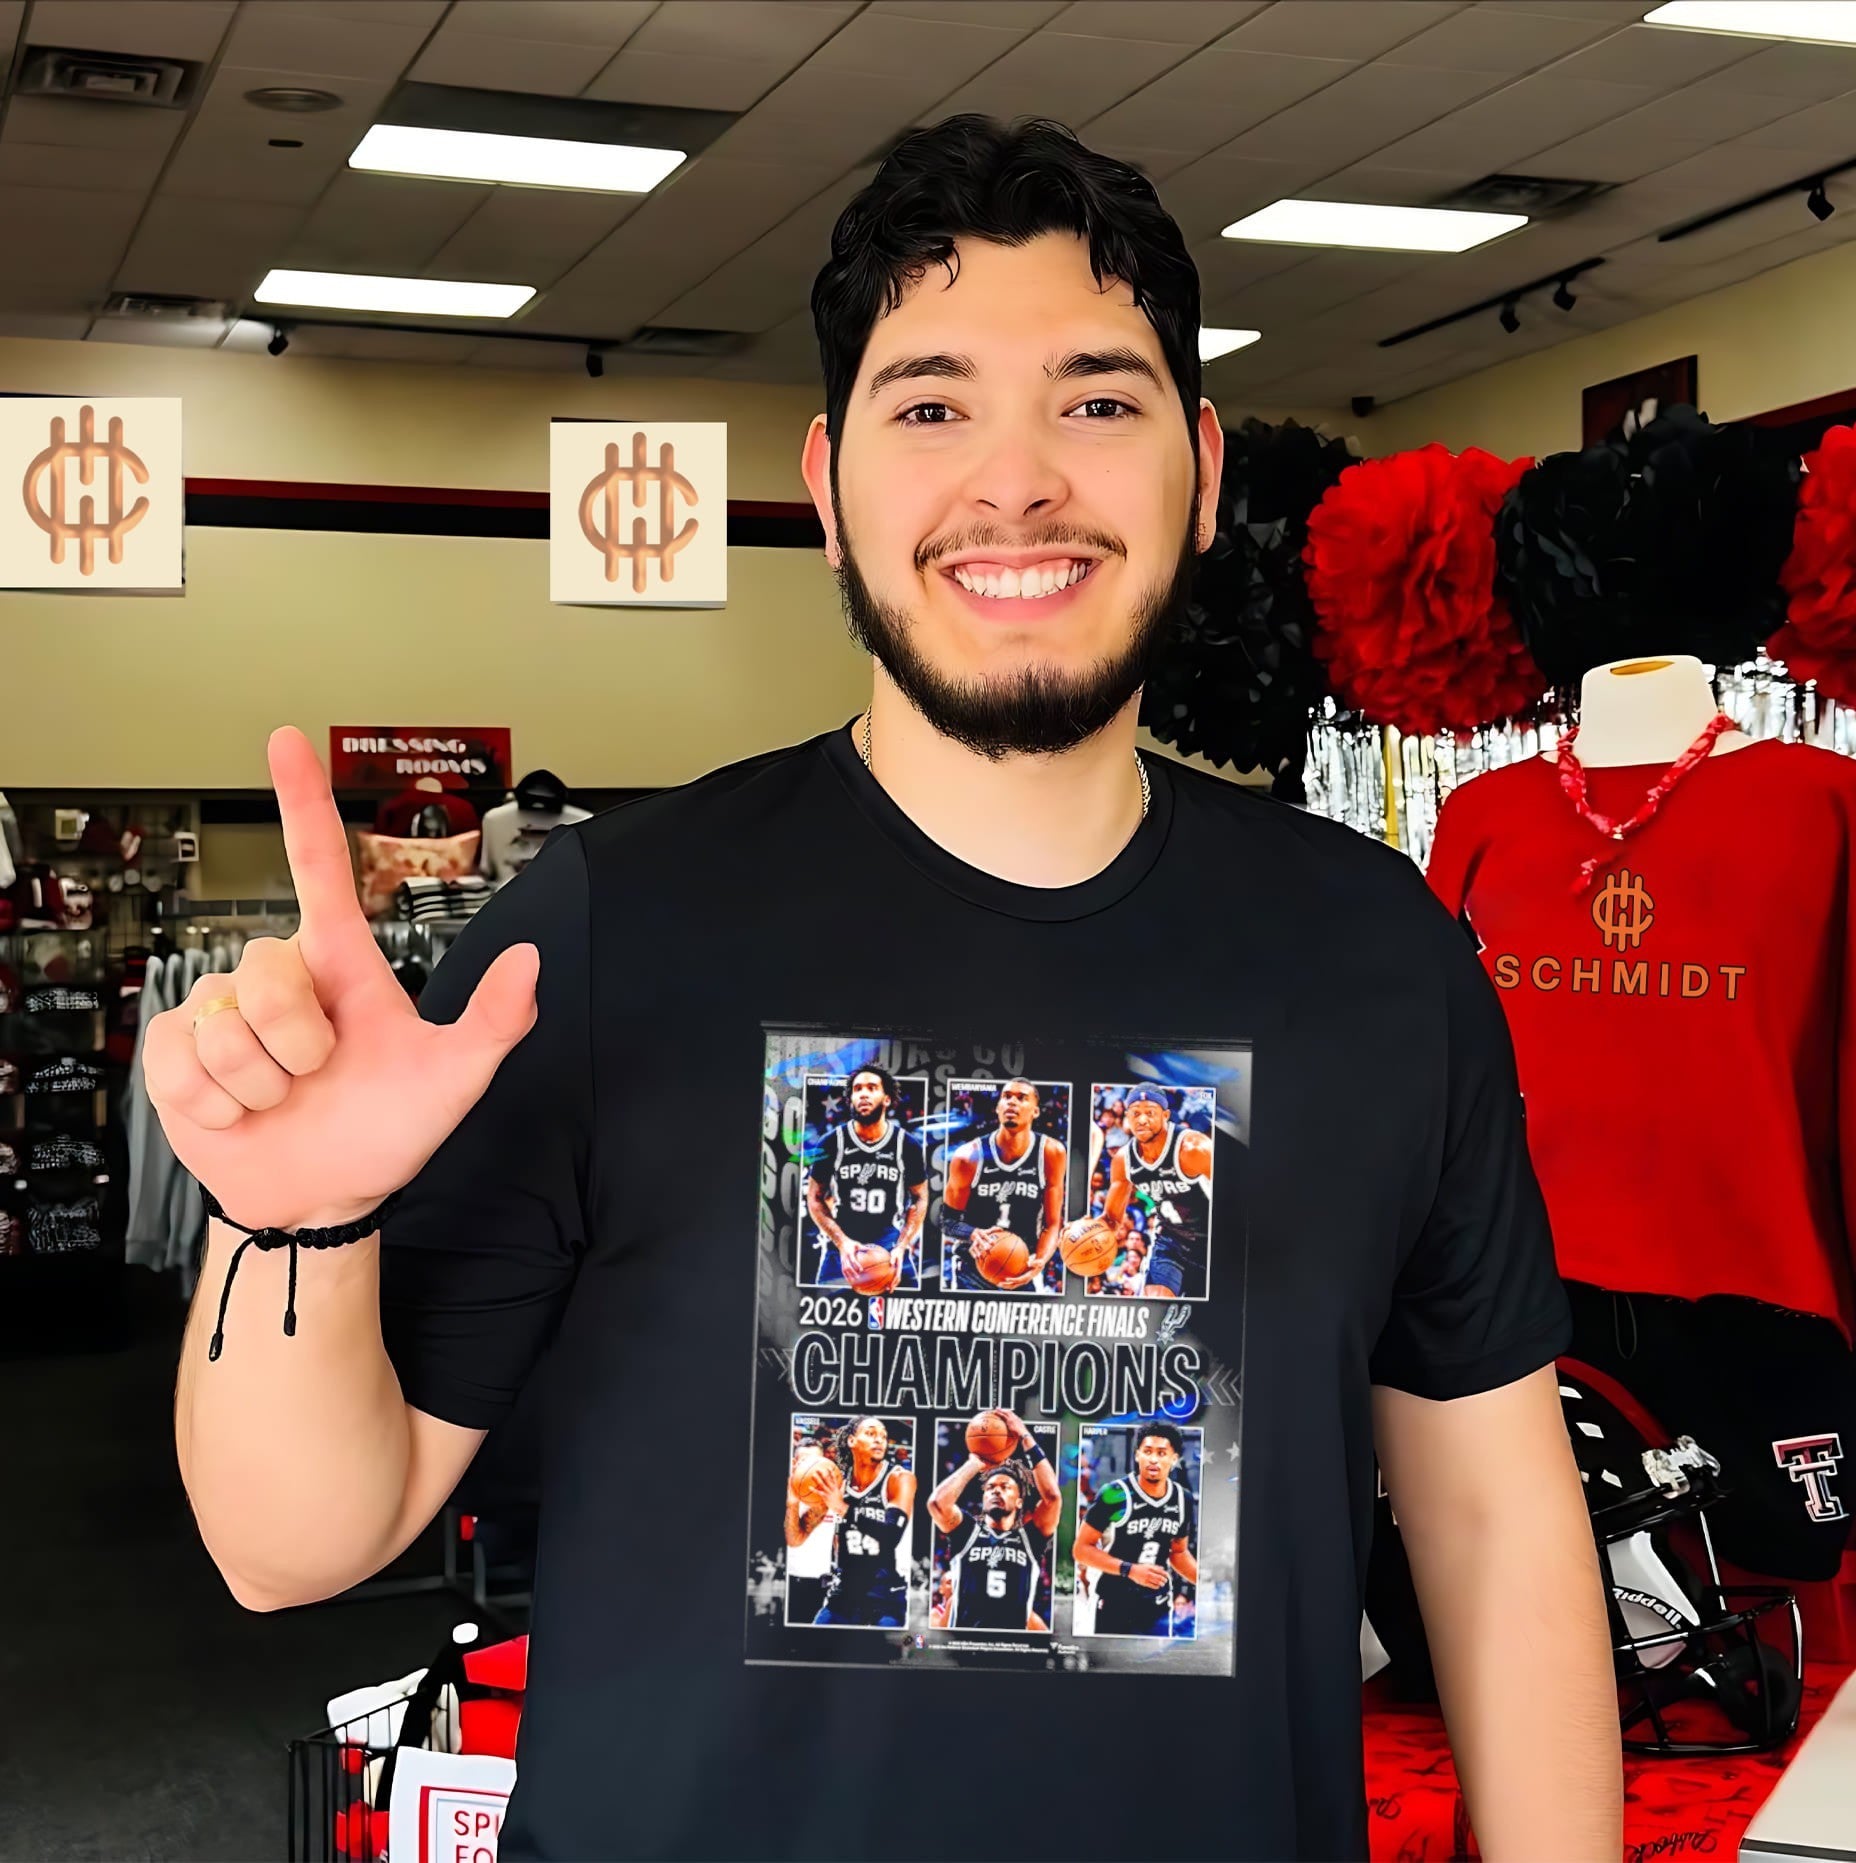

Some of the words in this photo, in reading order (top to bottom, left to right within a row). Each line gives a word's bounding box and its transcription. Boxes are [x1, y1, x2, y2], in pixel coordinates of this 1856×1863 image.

[342, 737, 467, 754] DRESSING
[396, 758, 487, 775] ROOMS
[1493, 953, 1747, 1001] SCHMIDT
[839, 1163, 899, 1185] SPURS
[849, 1187, 887, 1214] 30
[977, 1181, 1039, 1203] SPURS
[1136, 1180, 1192, 1201] PURS
[995, 1202, 1011, 1229] 1
[799, 1296, 863, 1328] 2026
[884, 1297, 971, 1333] WESTERN
[971, 1299, 1087, 1337] CONFERENCE
[1086, 1304, 1150, 1339] FINALS
[791, 1330, 1201, 1419] CHAMPIONS
[1033, 1425, 1058, 1435] CASTLE
[1083, 1427, 1109, 1436] HARPER
[1126, 1516, 1181, 1540] SPURS
[968, 1545, 1028, 1569] SPURS
[1137, 1540, 1161, 1566] 2
[985, 1569, 1007, 1599] 5
